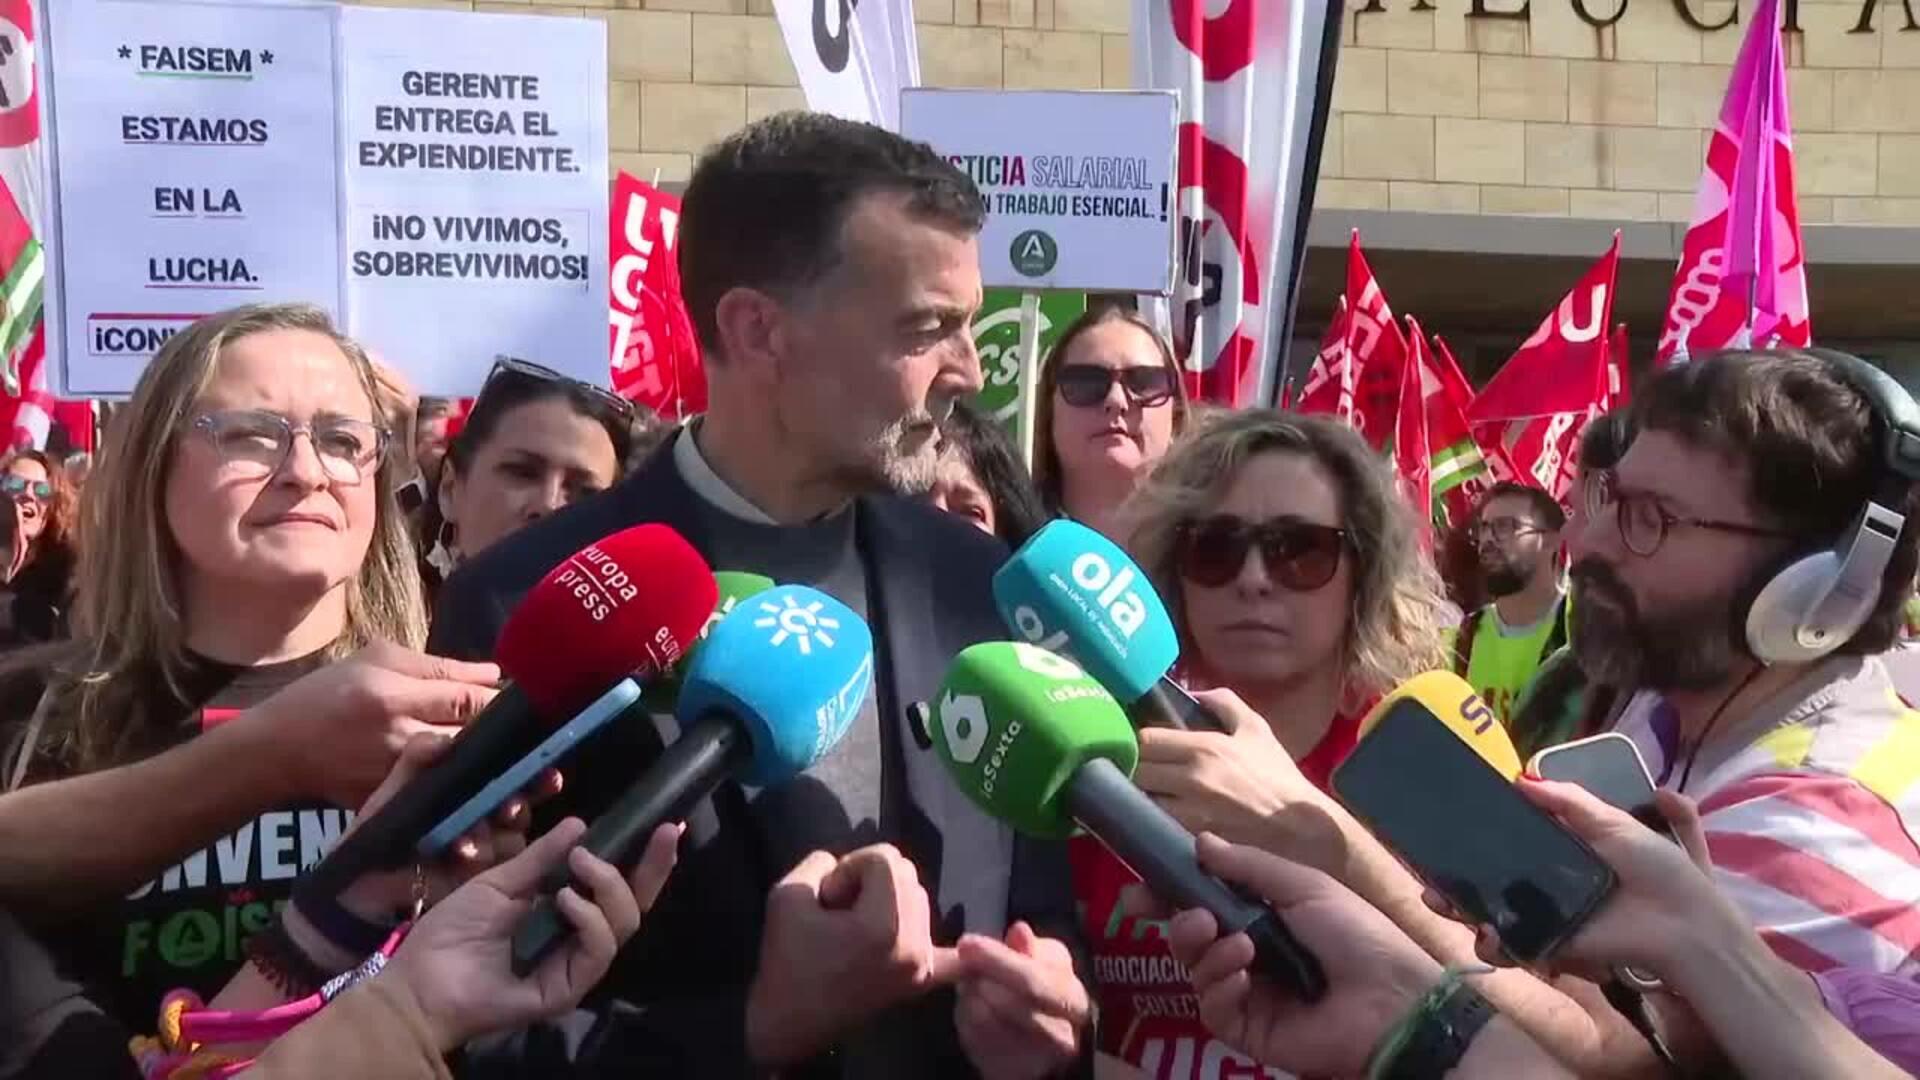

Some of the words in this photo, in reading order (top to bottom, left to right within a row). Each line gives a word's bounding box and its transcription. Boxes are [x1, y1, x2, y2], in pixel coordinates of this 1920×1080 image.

[140, 45, 252, 72] FAISEM
[402, 71, 539, 100] GERENTE
[122, 116, 268, 143] ESTAMOS
[375, 106, 516, 134] ENTREGA
[523, 111, 558, 136] EL
[359, 142, 580, 172] EXPIENDIENTE.
[1032, 156, 1152, 189] SALARIAL
[155, 187, 194, 212] EN
[203, 189, 242, 212] LA
[996, 194, 1067, 215] TRABAJO
[1072, 196, 1155, 218] ESENCIAL.
[433, 216, 569, 248] VIVIMOS,
[150, 258, 258, 282] LUCHA.
[353, 251, 588, 281] SOBREVIVIMOS!
[95, 327, 175, 351] ¡CON
[553, 569, 610, 621] press
[1071, 552, 1146, 640] ola
